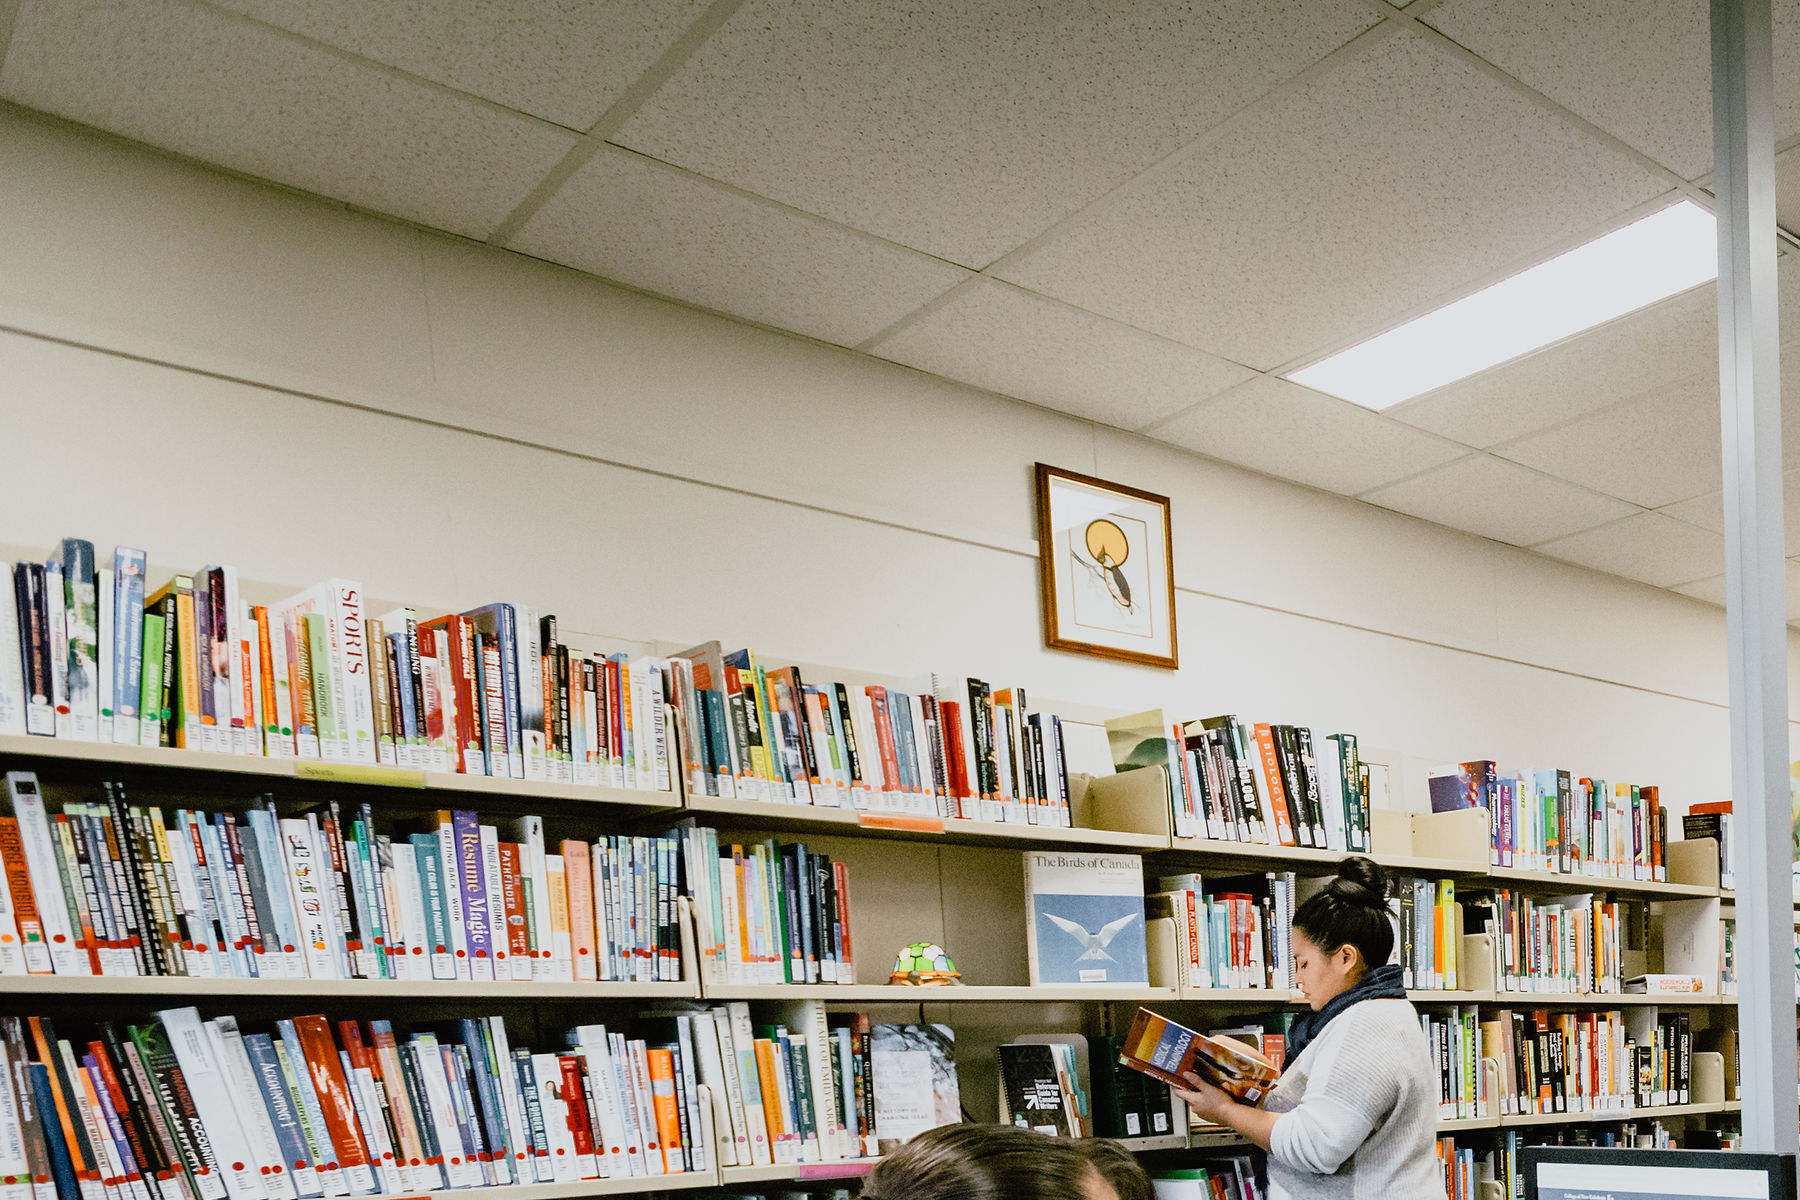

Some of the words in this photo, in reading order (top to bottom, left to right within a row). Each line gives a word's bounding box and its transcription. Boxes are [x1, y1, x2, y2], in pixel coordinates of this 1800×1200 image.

[130, 601, 142, 658] Environmental
[165, 613, 173, 652] ECOLOGICAL
[340, 588, 364, 675] SPORTS
[129, 659, 139, 687] Science
[318, 672, 328, 717] HANDBOOK
[974, 696, 982, 721] Student
[653, 698, 663, 734] WILDER
[745, 700, 757, 733] Moodle
[656, 737, 665, 761] WEST
[975, 722, 986, 761] Engagement
[1237, 760, 1257, 810] BIOLOGY
[1264, 743, 1283, 805] BIOLOGY
[1306, 765, 1319, 803] Biology
[1490, 793, 1498, 837] Pharmacology
[0, 824, 19, 866] GEORGE
[1503, 824, 1511, 845] GUIDE
[425, 856, 436, 872] WHAT
[427, 872, 438, 890] COLOR
[444, 830, 454, 864] GETTING
[452, 898, 460, 922] WORK
[461, 833, 481, 893] Résumé
[486, 844, 499, 892] UNBEATABLE
[501, 850, 515, 909] PATHFINDER
[1034, 856, 1056, 868] The
[1057, 856, 1086, 869] Birds
[1087, 856, 1098, 869] of
[1099, 857, 1140, 870] Canada
[8, 869, 36, 917] MONBIOT
[431, 897, 441, 911] YOUR
[465, 896, 489, 943] Magic
[1189, 912, 1197, 933] PLANTS
[815, 1006, 826, 1026] THE
[817, 1028, 828, 1049] ART
[819, 1050, 829, 1065] OF
[1154, 1042, 1172, 1066] MEDICAL
[1166, 1031, 1192, 1072] TERMINOLOGY
[259, 1062, 292, 1121] ACCOUNTING
[821, 1066, 832, 1098] EMILY
[78, 1096, 97, 1127] EMPLOYEE
[171, 1069, 195, 1116] FINANCIAL
[188, 1117, 219, 1175] ACCOUNTING
[306, 1103, 333, 1156] MANAGERS
[824, 1099, 835, 1127] CARR
[86, 1128, 108, 1169] MANAGEMENT
[304, 1127, 315, 1142] BOOT
[308, 1143, 320, 1159] CAMP
